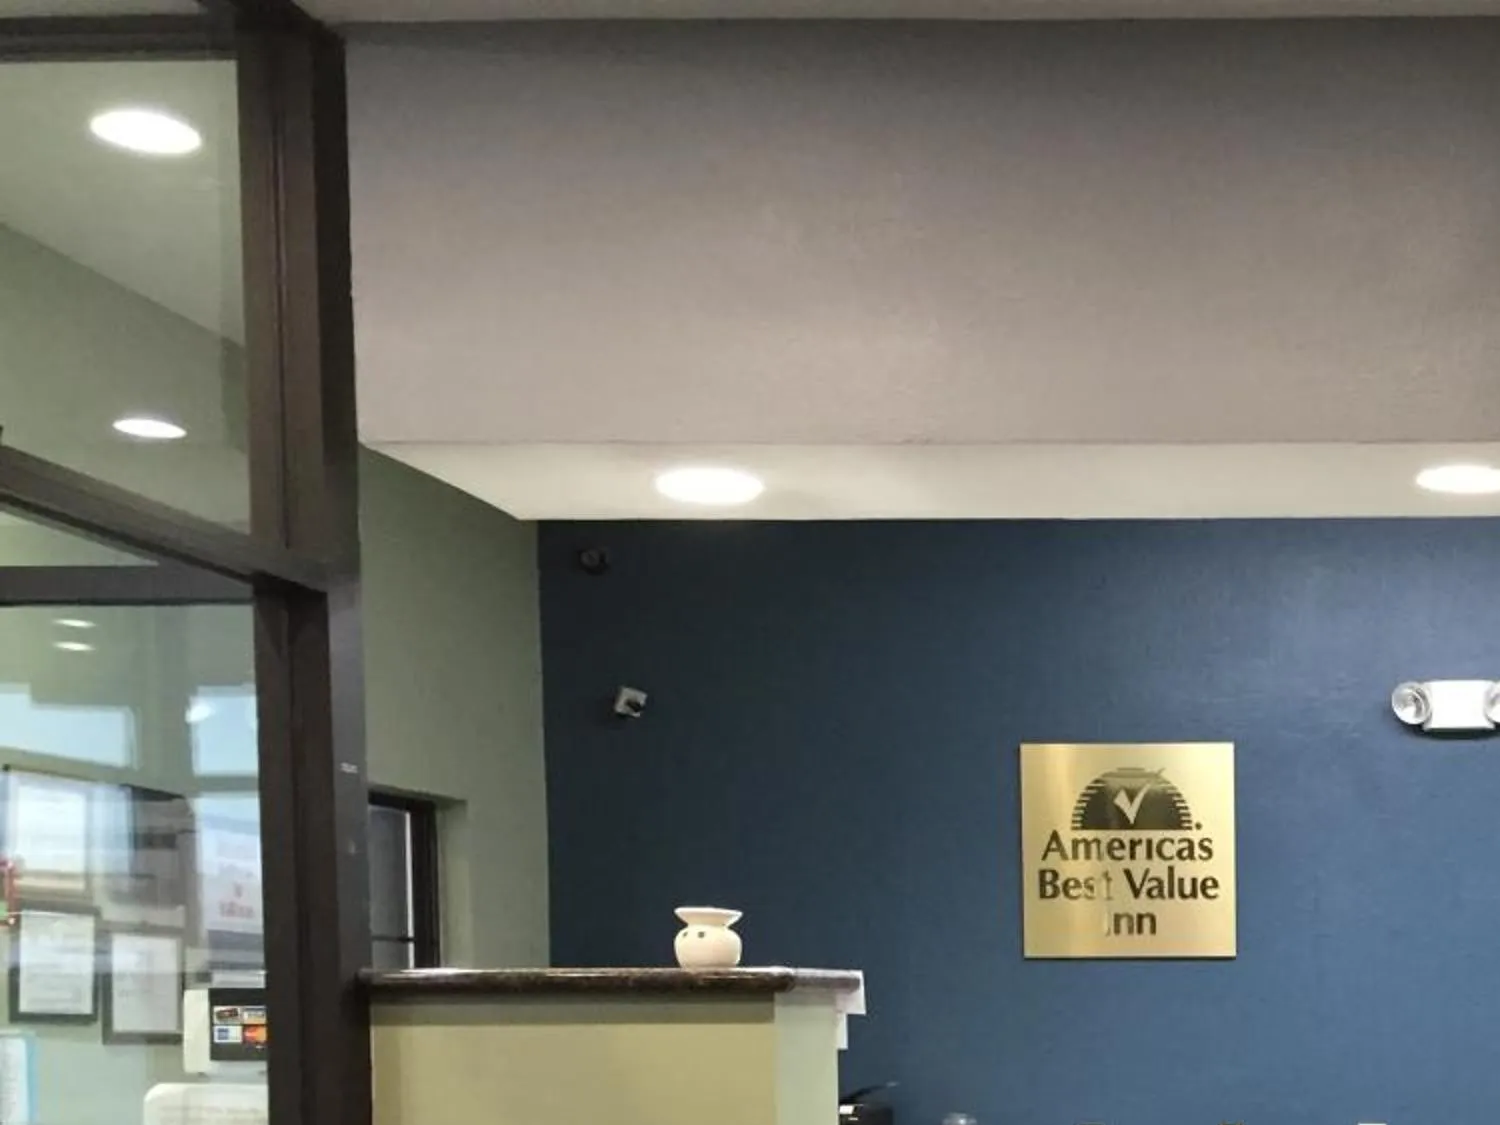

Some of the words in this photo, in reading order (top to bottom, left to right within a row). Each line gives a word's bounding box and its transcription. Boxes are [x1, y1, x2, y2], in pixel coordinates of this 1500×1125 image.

[1040, 829, 1215, 862] Americas
[1038, 868, 1114, 901] Best
[1123, 865, 1220, 900] Value
[1105, 907, 1157, 937] nn
